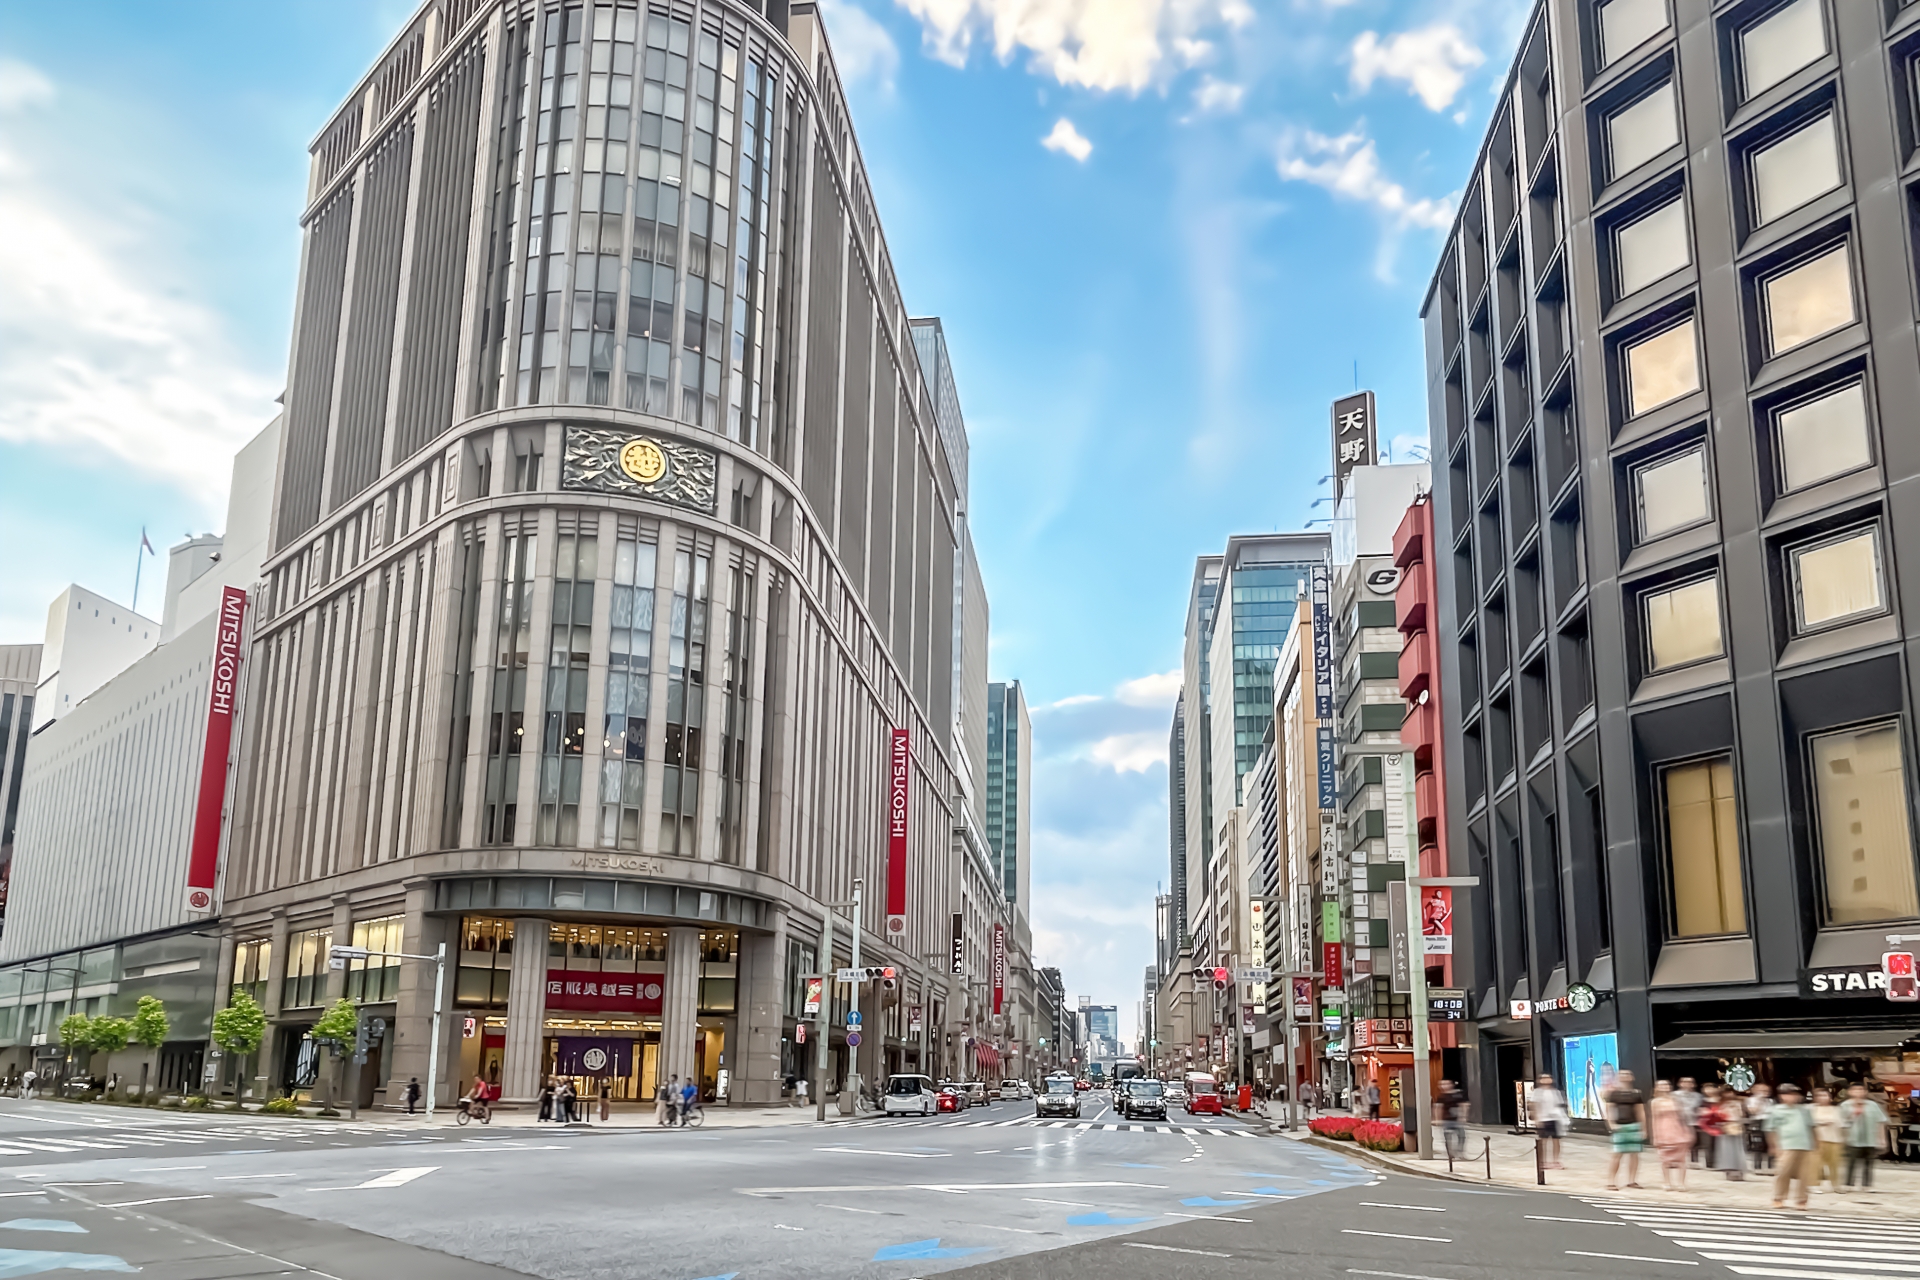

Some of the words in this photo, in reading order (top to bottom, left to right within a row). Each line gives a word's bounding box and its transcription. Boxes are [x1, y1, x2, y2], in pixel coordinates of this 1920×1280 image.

[1367, 569, 1398, 585] G
[213, 595, 241, 715] MITSUKOSHI
[892, 736, 906, 838] MITSUKOSHI
[569, 857, 665, 874] MITSUKOSHI
[995, 930, 1003, 988] MITSUKOSHI
[1812, 971, 1887, 992] STAR
[1447, 1011, 1460, 1019] 34
